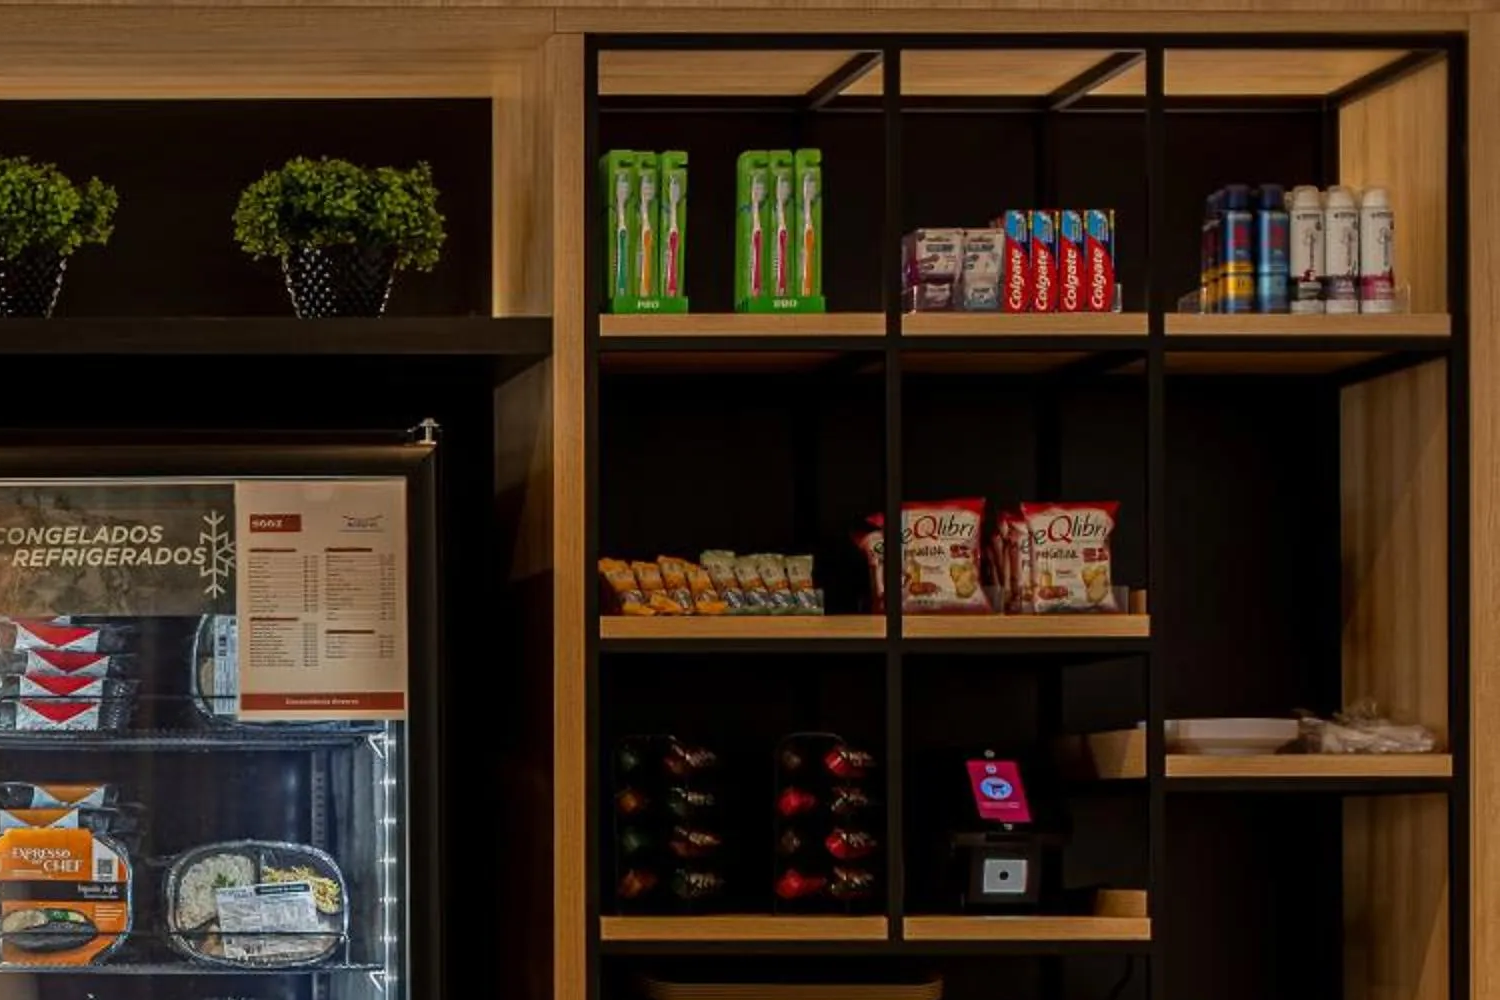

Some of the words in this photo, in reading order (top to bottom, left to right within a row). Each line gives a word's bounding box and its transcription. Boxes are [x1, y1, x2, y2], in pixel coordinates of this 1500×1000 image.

[1008, 248, 1025, 310] Colgate
[1035, 248, 1051, 311] Colgate
[1063, 248, 1078, 311] Colgate
[1091, 247, 1107, 311] Colgate
[11, 547, 207, 568] REFRIGERADOS
[43, 859, 85, 873] CHEF
